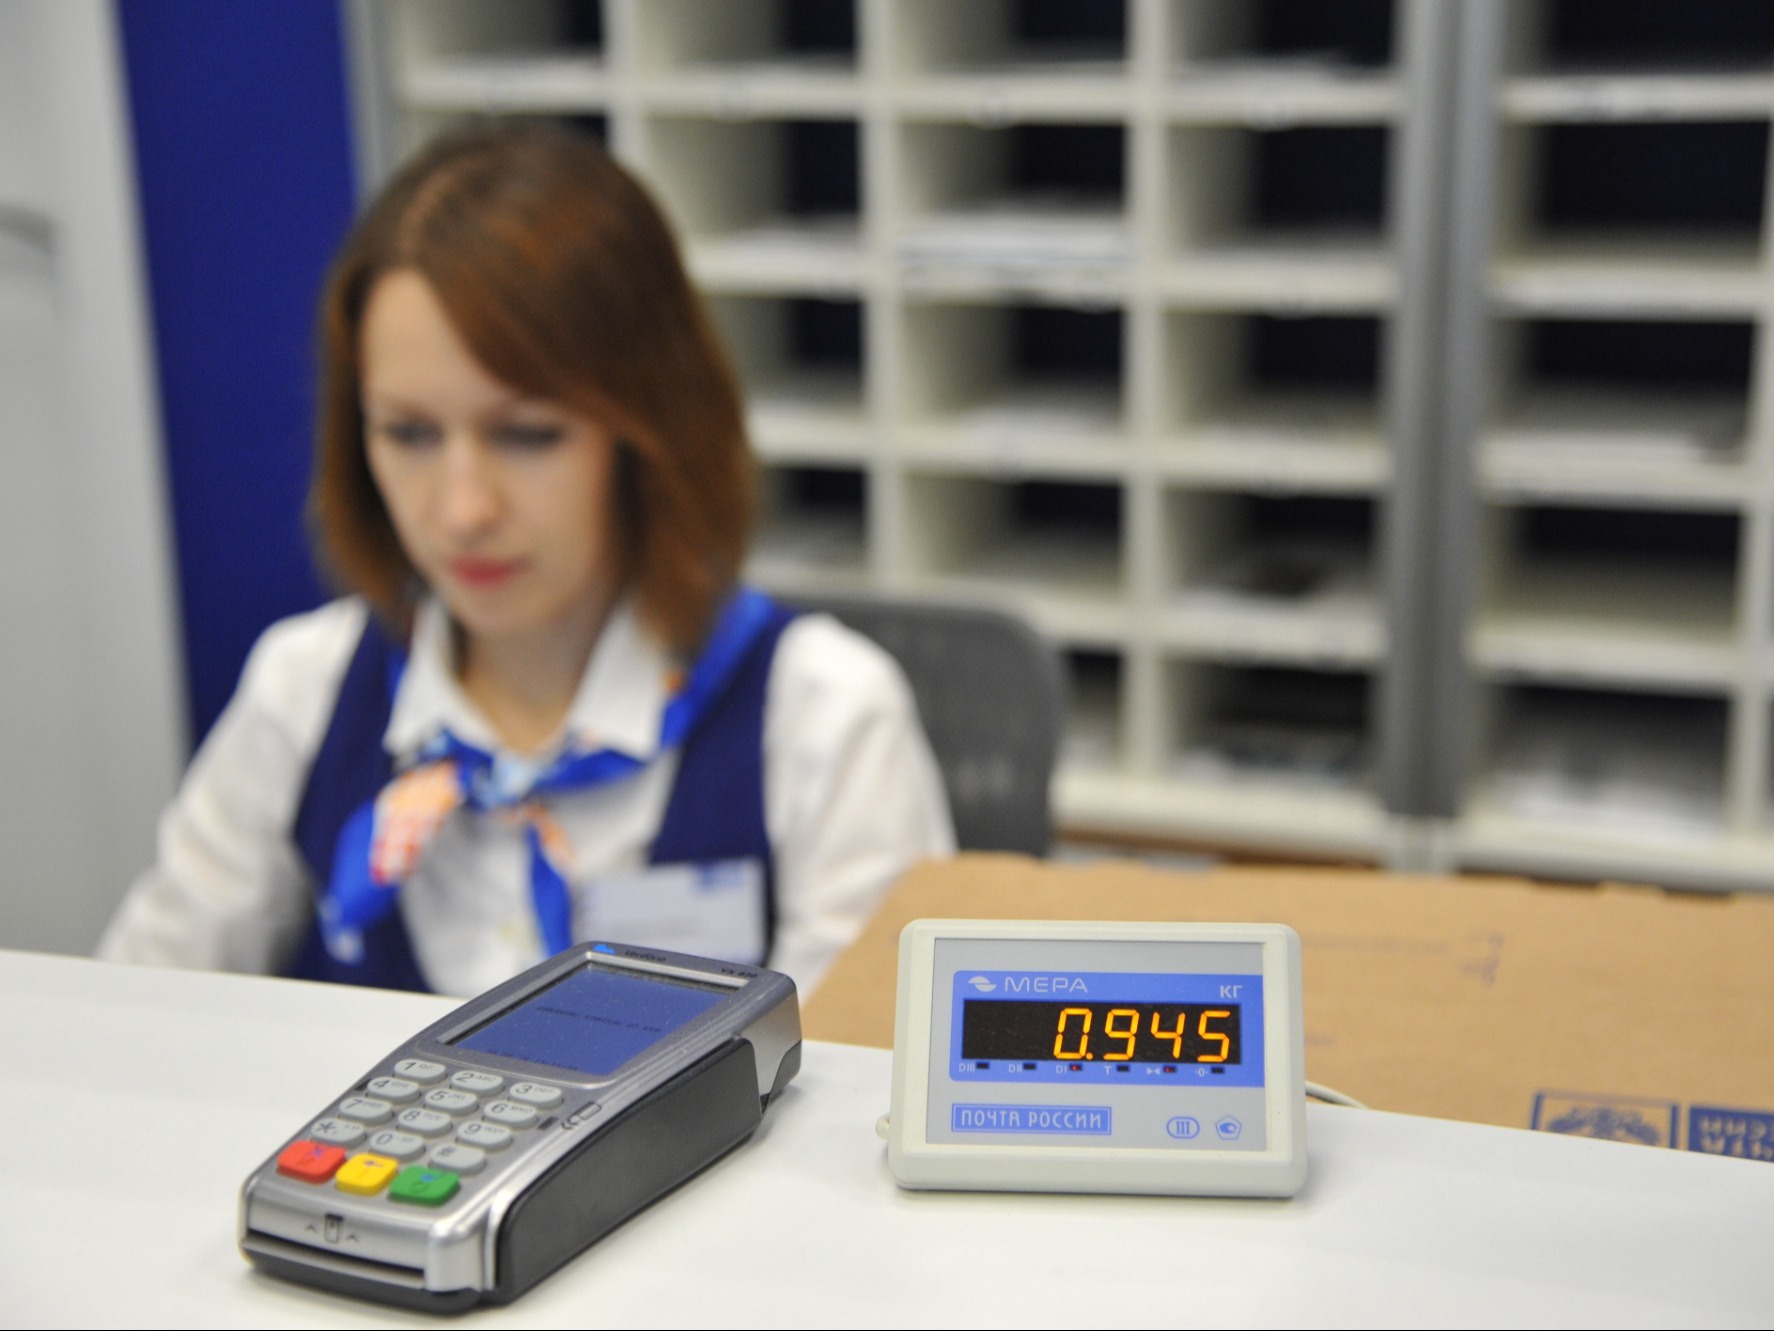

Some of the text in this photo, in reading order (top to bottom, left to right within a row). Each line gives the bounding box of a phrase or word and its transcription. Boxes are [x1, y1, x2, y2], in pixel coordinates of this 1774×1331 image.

[1004, 976, 1088, 993] МЕРА
[1053, 1007, 1231, 1063] 0.945
[404, 1062, 416, 1071] 1
[455, 1072, 474, 1083] 2
[373, 1080, 390, 1089] 4
[515, 1084, 533, 1095] 3
[430, 1091, 449, 1101] 5
[346, 1099, 362, 1109] 7
[491, 1103, 508, 1114] 6
[403, 1110, 420, 1121] 8
[961, 1109, 1101, 1129] ПОЧТА РОССИИ
[464, 1124, 481, 1135] 9
[376, 1133, 393, 1145] 0
